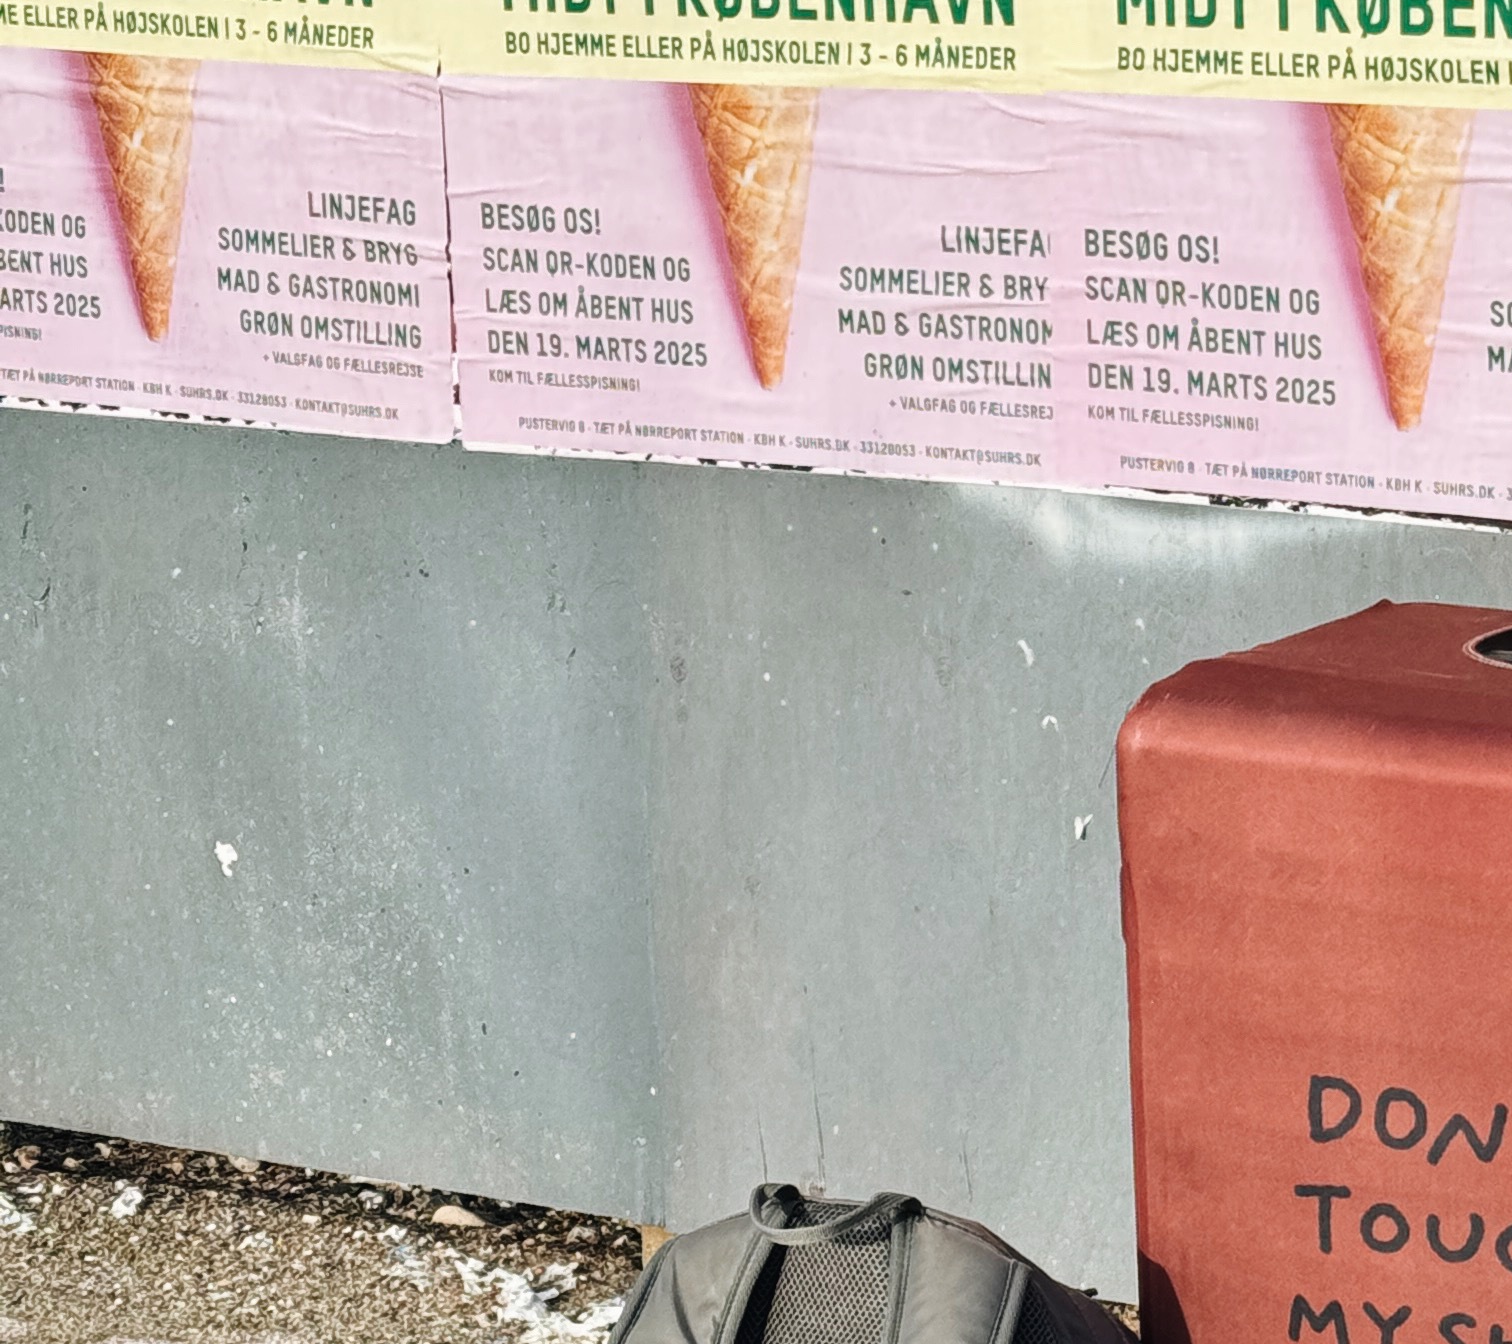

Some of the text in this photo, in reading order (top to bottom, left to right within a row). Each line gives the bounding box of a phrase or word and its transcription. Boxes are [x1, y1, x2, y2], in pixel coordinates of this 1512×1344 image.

[308, 191, 415, 226] LINJEFAG
[481, 202, 601, 235] BESØG OS!
[1085, 229, 1219, 264] BESØG OS!
[1084, 276, 1319, 315] SCAN QR-KODEN OG
